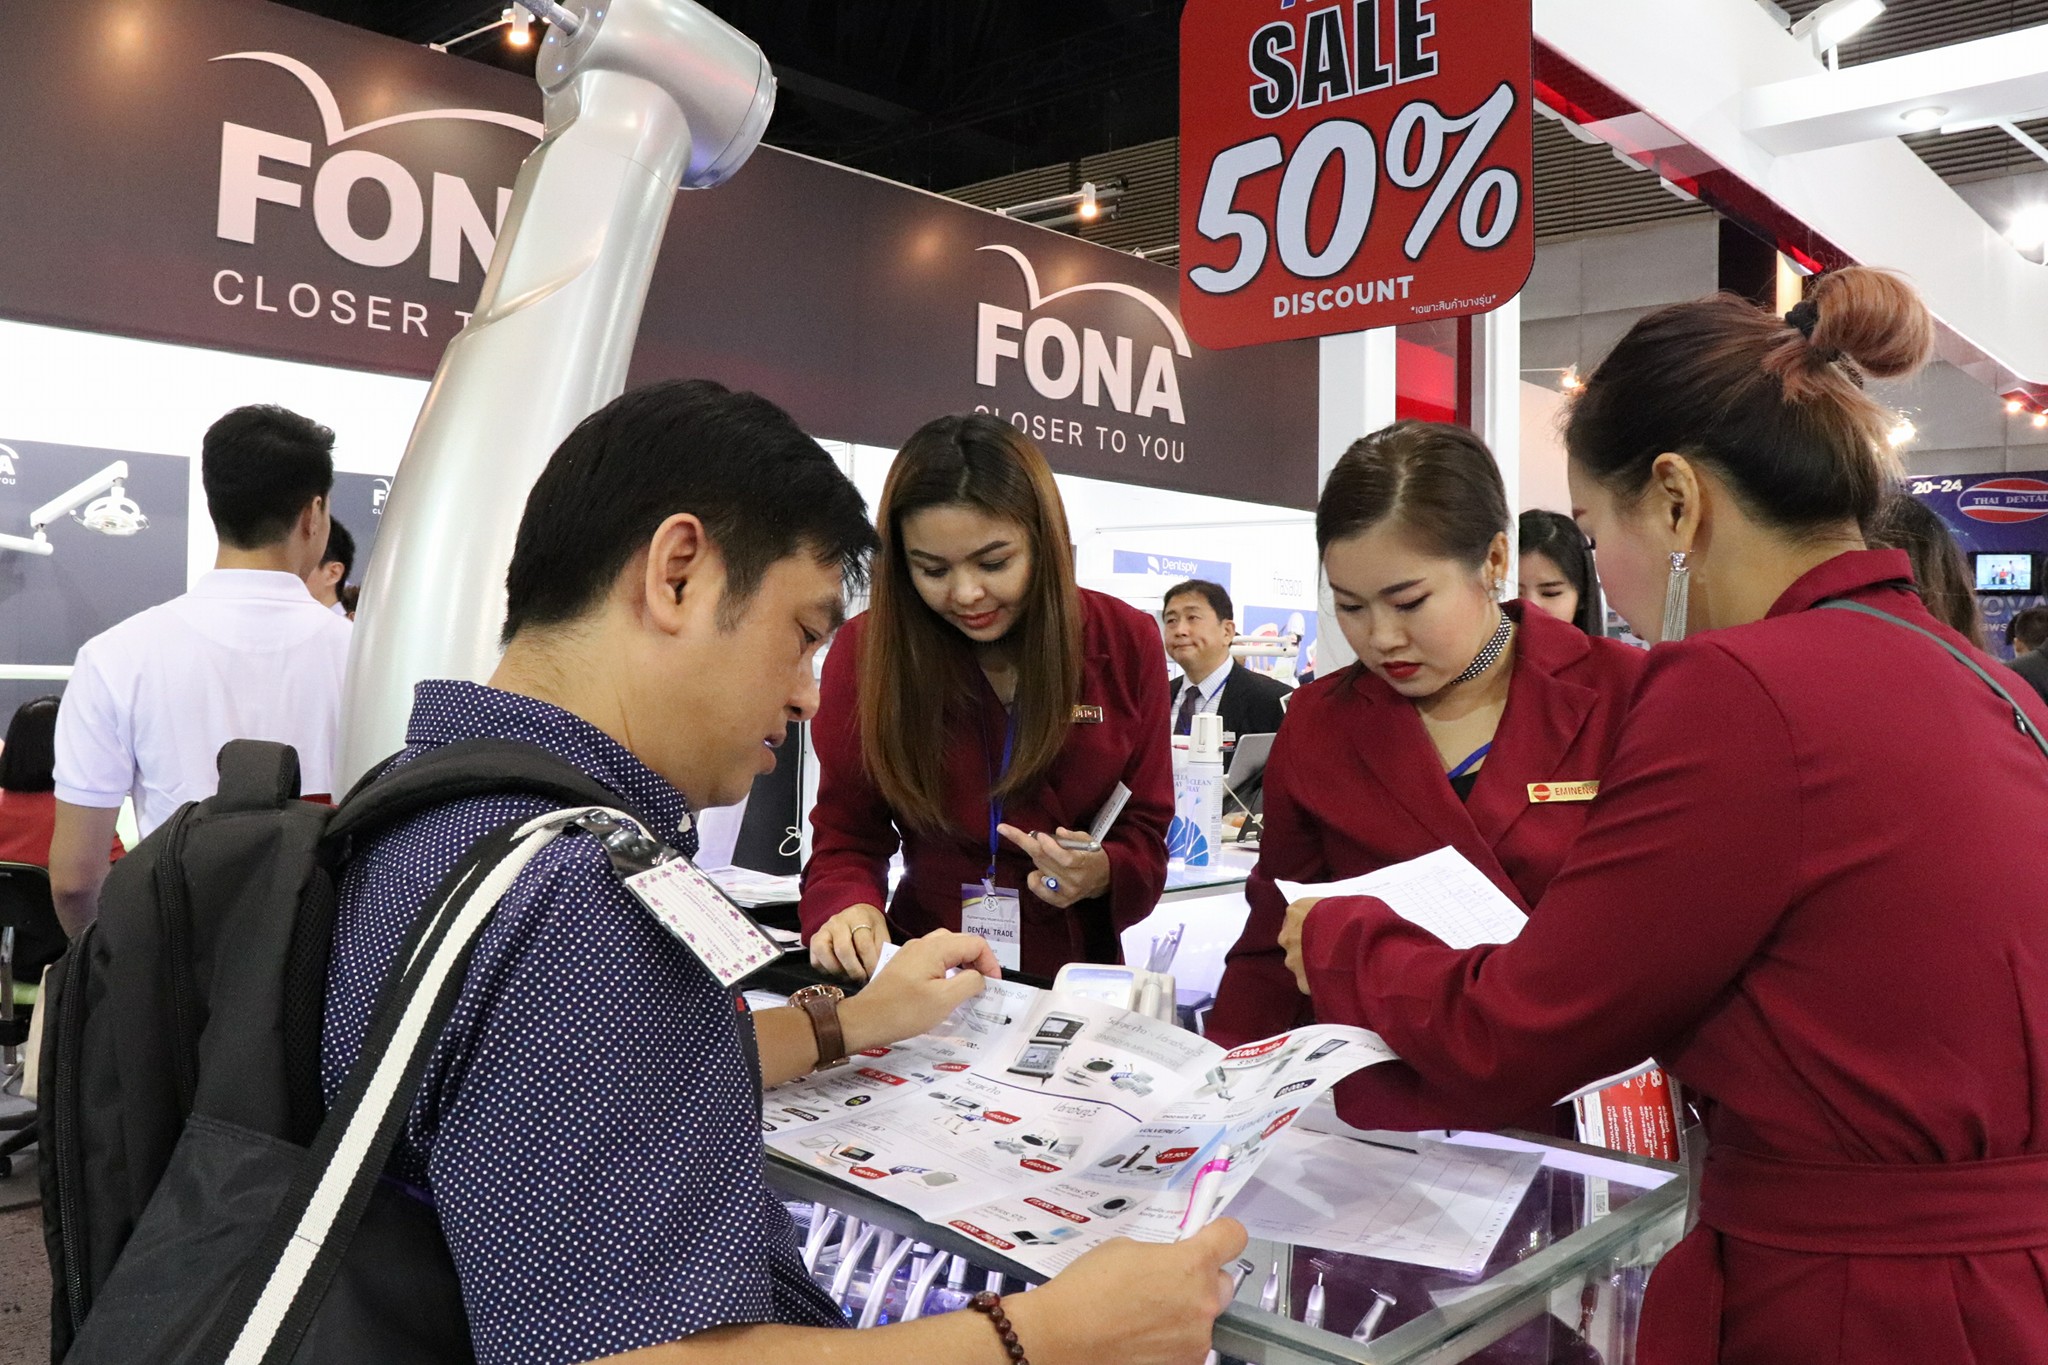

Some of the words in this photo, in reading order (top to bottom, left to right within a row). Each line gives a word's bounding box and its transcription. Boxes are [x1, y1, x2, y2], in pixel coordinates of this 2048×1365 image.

[1249, 0, 1439, 119] SALE
[1187, 80, 1522, 294] 50%
[213, 269, 429, 336] CLOSER
[1273, 275, 1414, 318] DISCOUNT
[976, 302, 1186, 424] FONA
[974, 405, 1083, 447] OSER
[1096, 426, 1127, 453] TO
[1138, 433, 1185, 463] YOU
[1912, 479, 1963, 495] 20-24
[1973, 497, 1999, 505] THAI
[1162, 558, 1198, 574] Dentsply
[967, 926, 991, 935] DENTAL
[993, 929, 1013, 937] TRADE
